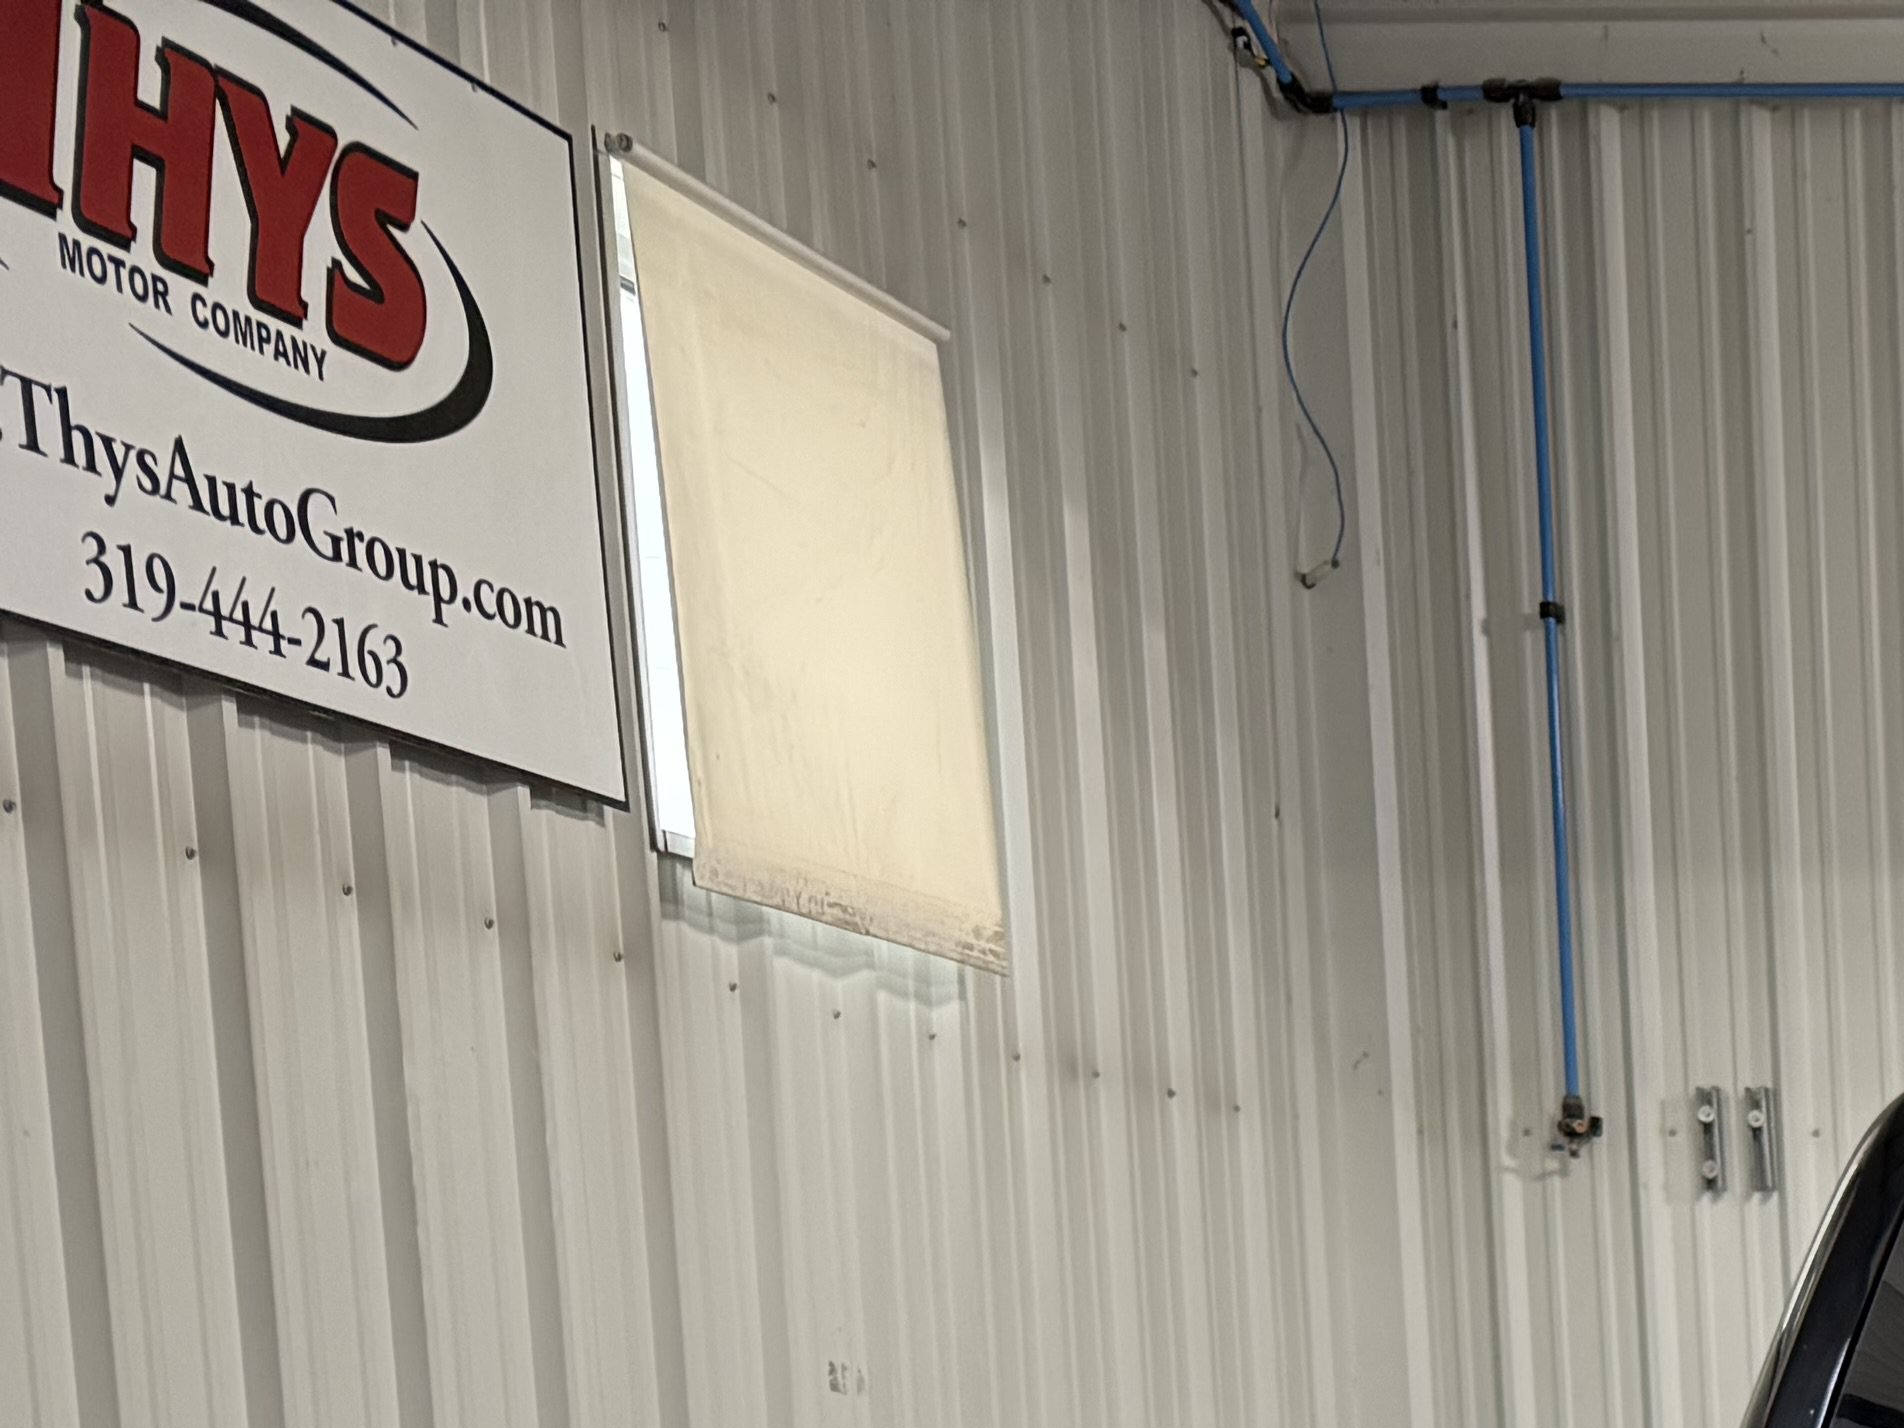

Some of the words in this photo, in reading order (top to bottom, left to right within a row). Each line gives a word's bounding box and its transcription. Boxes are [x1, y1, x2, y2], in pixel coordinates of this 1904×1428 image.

[58, 232, 172, 316] MOTOR
[191, 292, 327, 382] COMPANY
[0, 364, 567, 650] ThysAutoGroup.com
[80, 530, 410, 700] 319-444-2163
